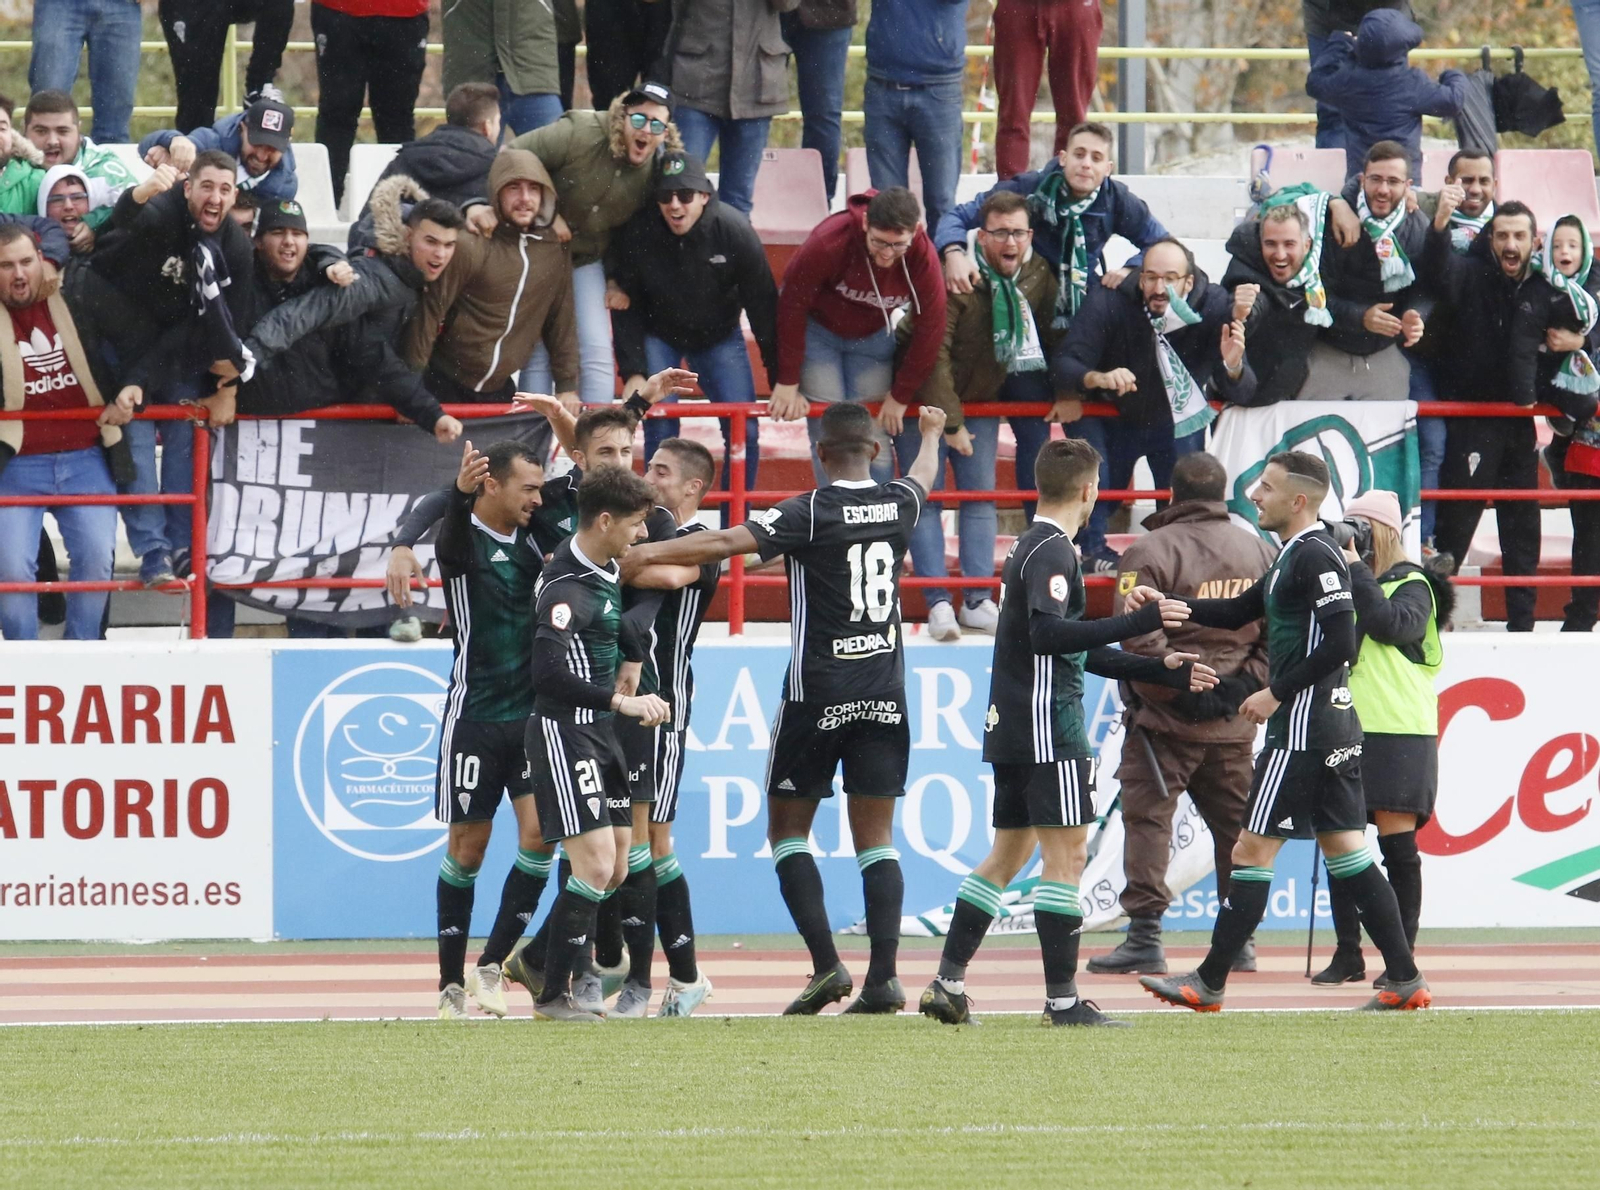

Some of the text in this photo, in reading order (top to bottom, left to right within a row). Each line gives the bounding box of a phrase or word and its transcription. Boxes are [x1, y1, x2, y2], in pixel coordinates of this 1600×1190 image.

[24, 372, 78, 395] adida
[843, 502, 899, 524] ESCOBAR
[847, 541, 896, 623] 18
[1196, 578, 1259, 599] AVIZO
[823, 700, 897, 717] CORHYUND
[841, 711, 902, 725] HYUNDAI
[455, 752, 480, 790] 10
[574, 758, 603, 795] 21
[1416, 677, 1600, 857] Ce
[346, 783, 435, 795] FARMACÉUTICOS
